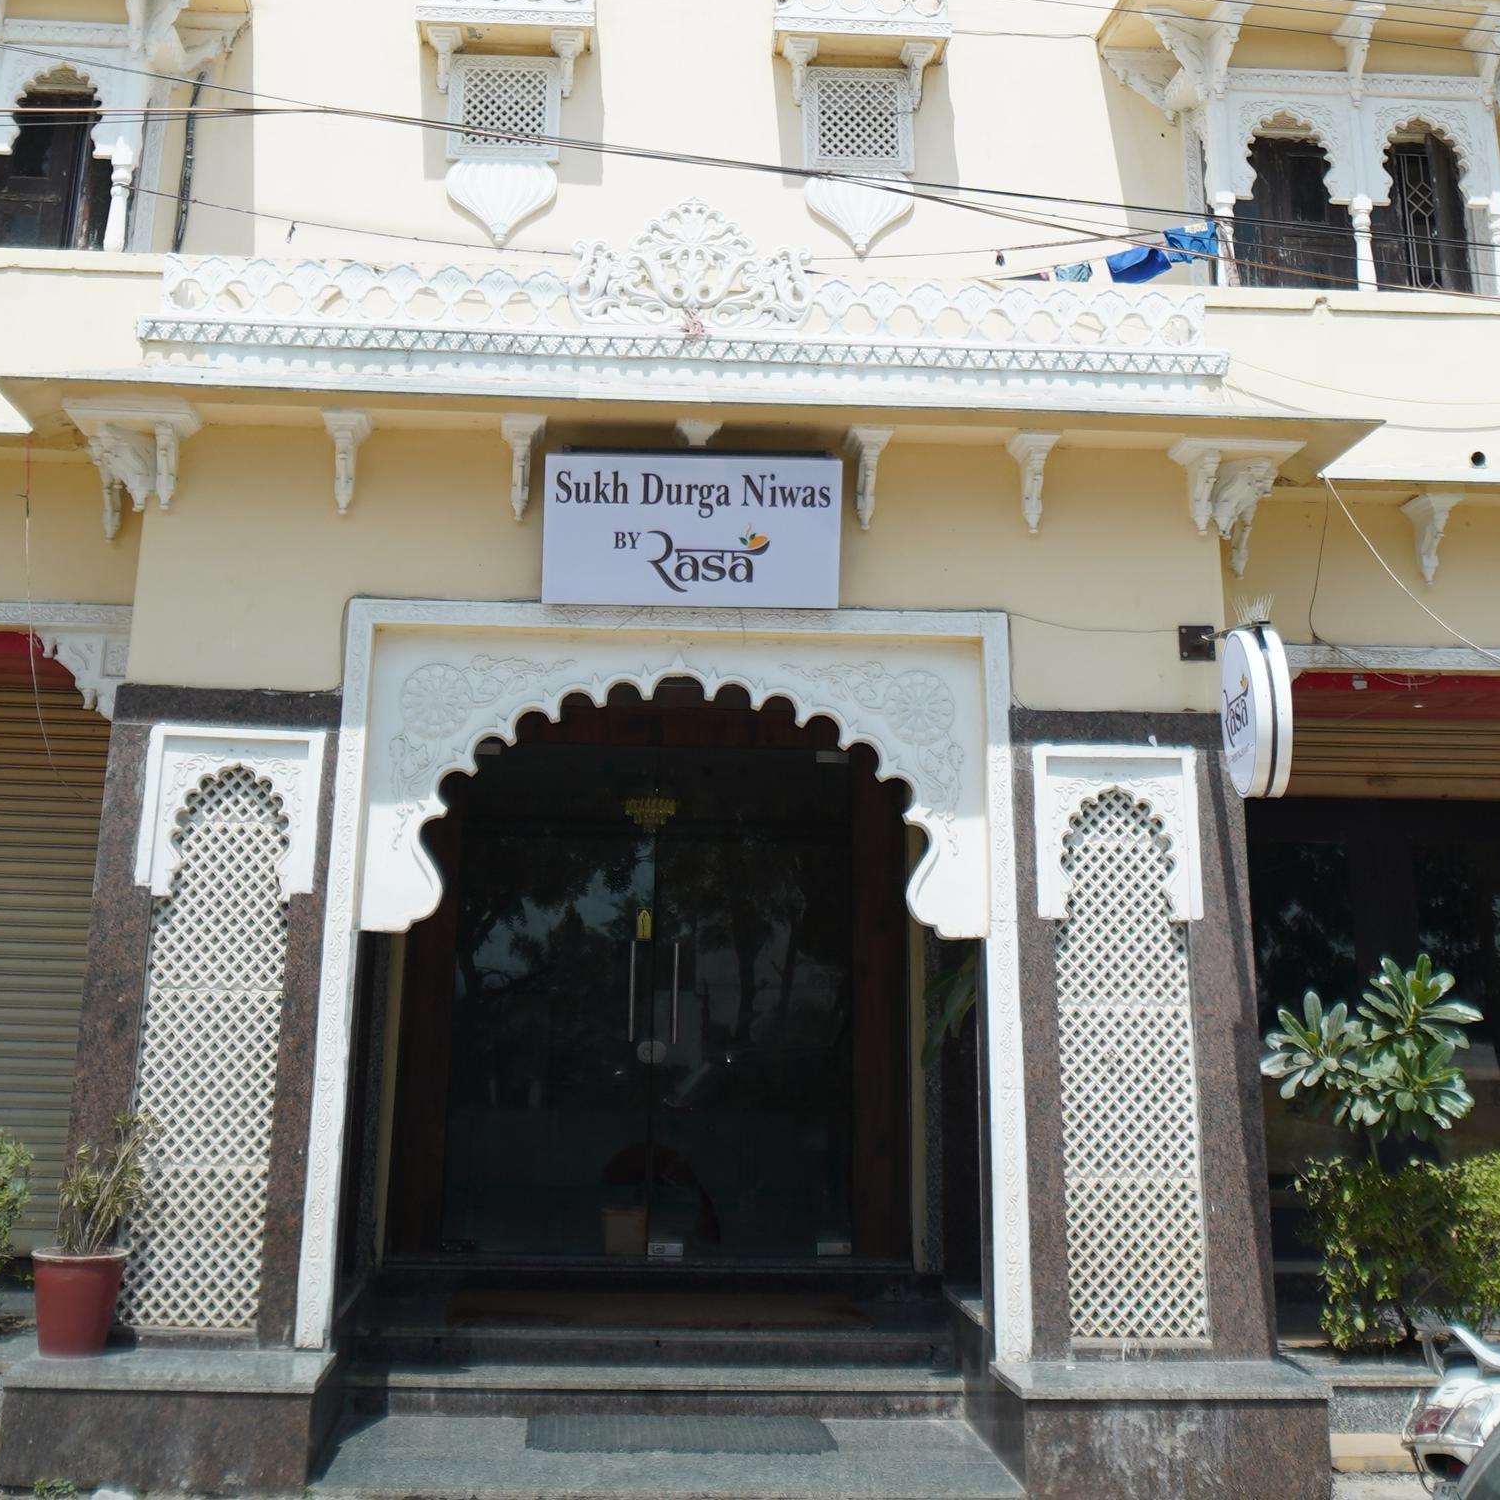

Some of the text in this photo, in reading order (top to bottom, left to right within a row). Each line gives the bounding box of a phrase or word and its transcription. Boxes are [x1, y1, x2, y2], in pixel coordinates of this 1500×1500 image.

[555, 470, 832, 518] Sukh Durga Niwas
[613, 530, 770, 592] BY Rasa
